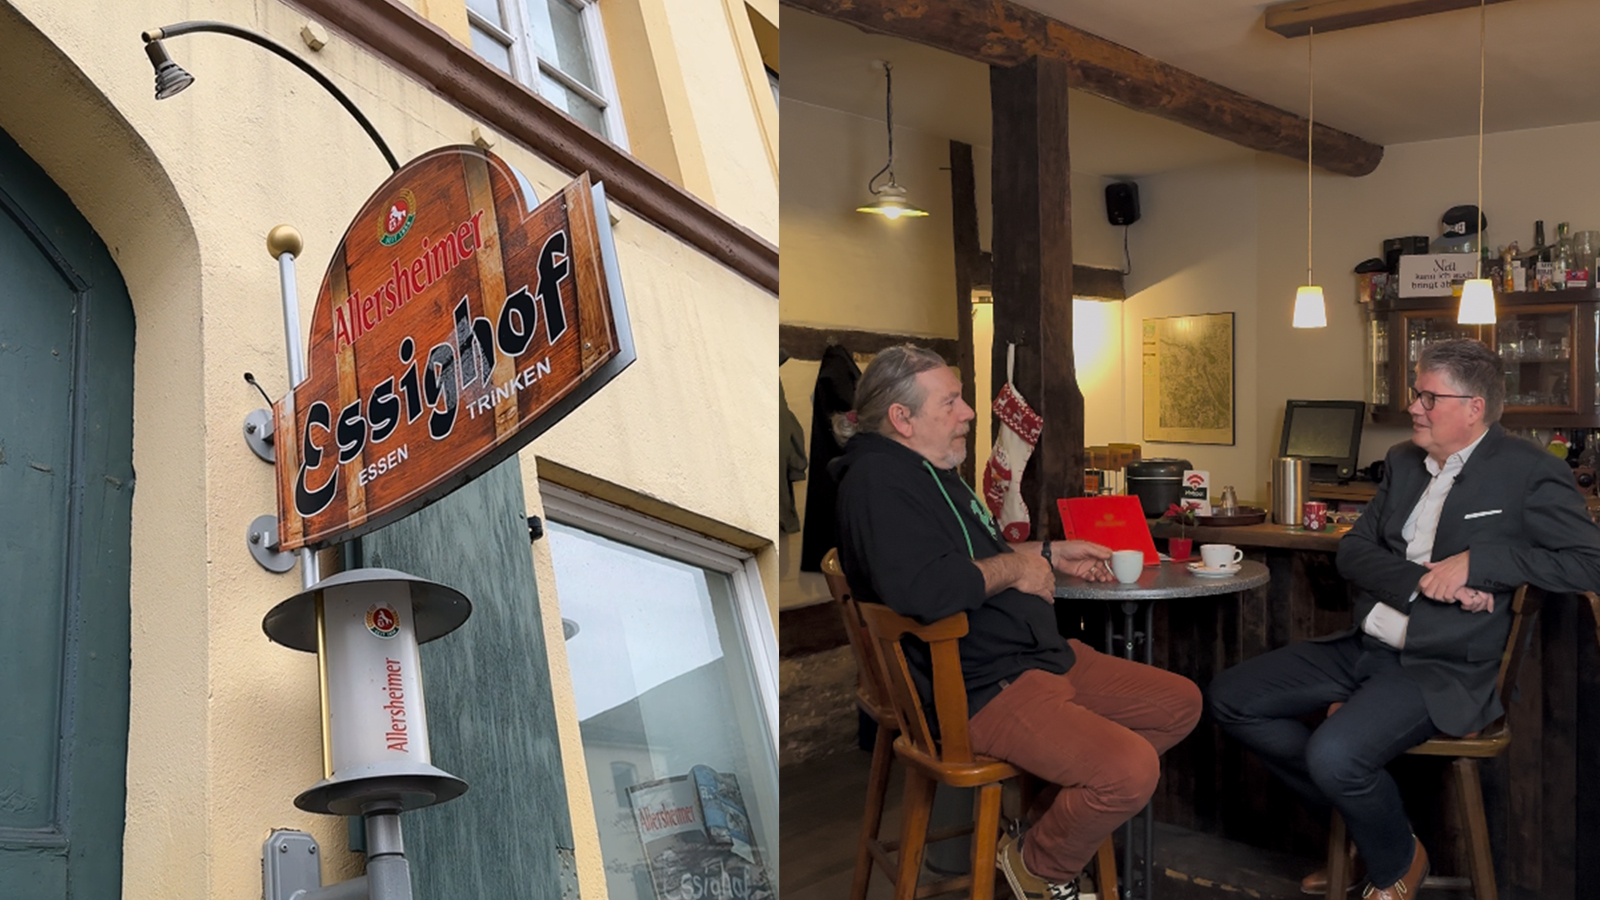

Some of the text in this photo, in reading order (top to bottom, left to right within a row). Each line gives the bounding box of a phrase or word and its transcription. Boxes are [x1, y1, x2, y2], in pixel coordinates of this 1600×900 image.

[335, 208, 485, 355] Allersheimer
[294, 229, 570, 517] Essighof
[465, 356, 552, 421] TRINKEN
[357, 443, 410, 487] ESSEN
[382, 657, 409, 753] Allersheimer
[637, 802, 696, 832] Allersheimer
